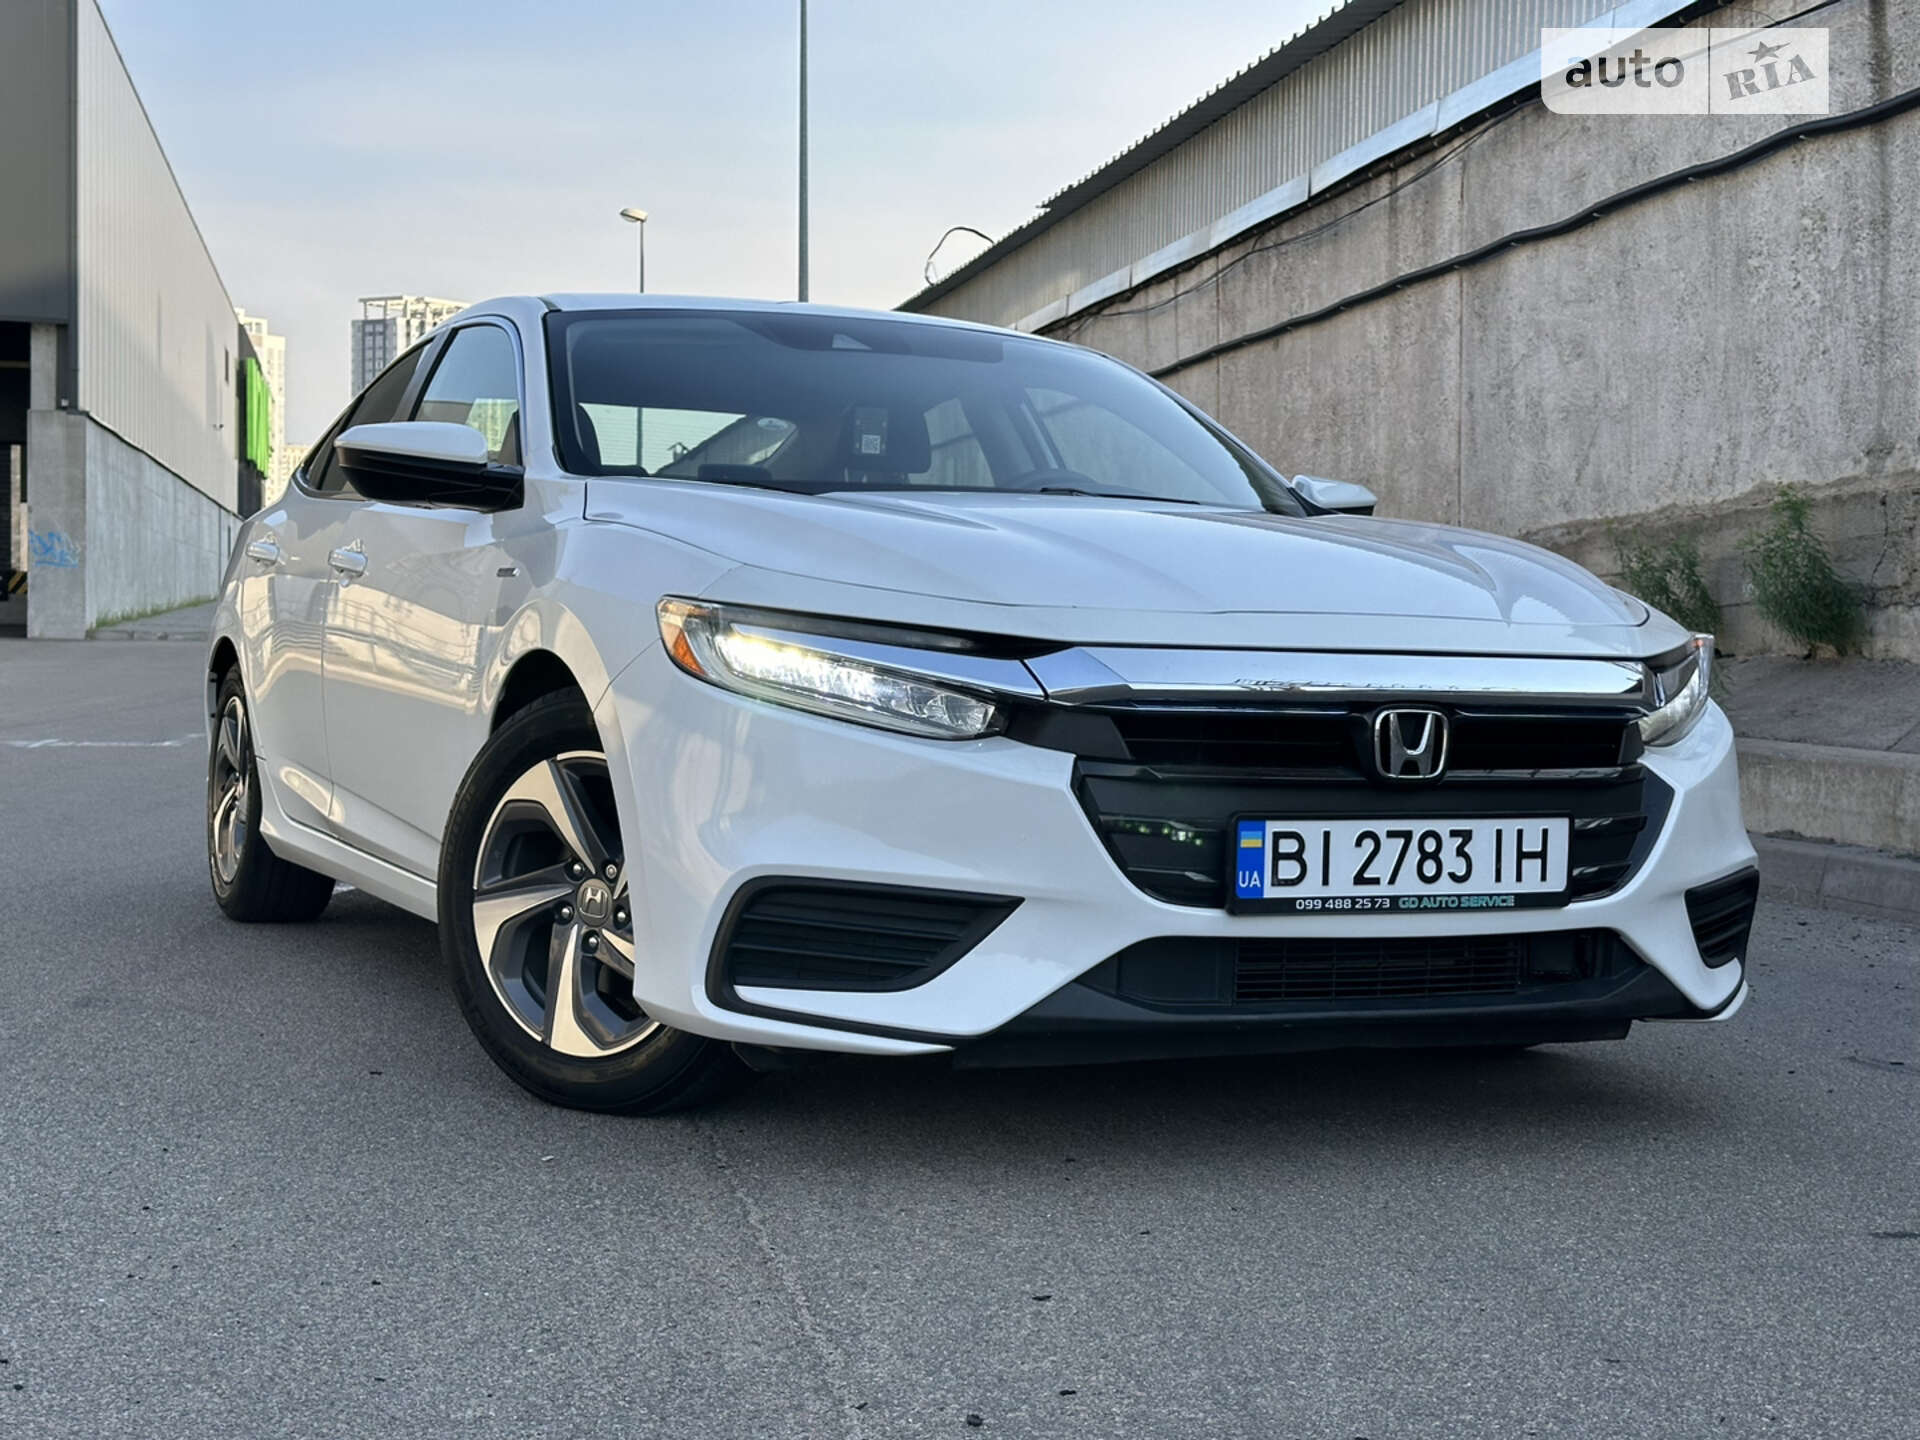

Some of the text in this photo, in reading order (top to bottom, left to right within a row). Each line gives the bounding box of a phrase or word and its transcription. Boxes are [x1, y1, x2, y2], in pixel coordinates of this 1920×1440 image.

[1270, 827, 1549, 887] BI 2783 IH
[1238, 870, 1262, 889] UA
[1295, 898, 1322, 911] 099
[1324, 898, 1352, 910] 488
[1354, 897, 1372, 909] 25
[1374, 897, 1391, 909] 73
[1420, 896, 1459, 908] AUTO
[1460, 895, 1516, 908] SERVICE
